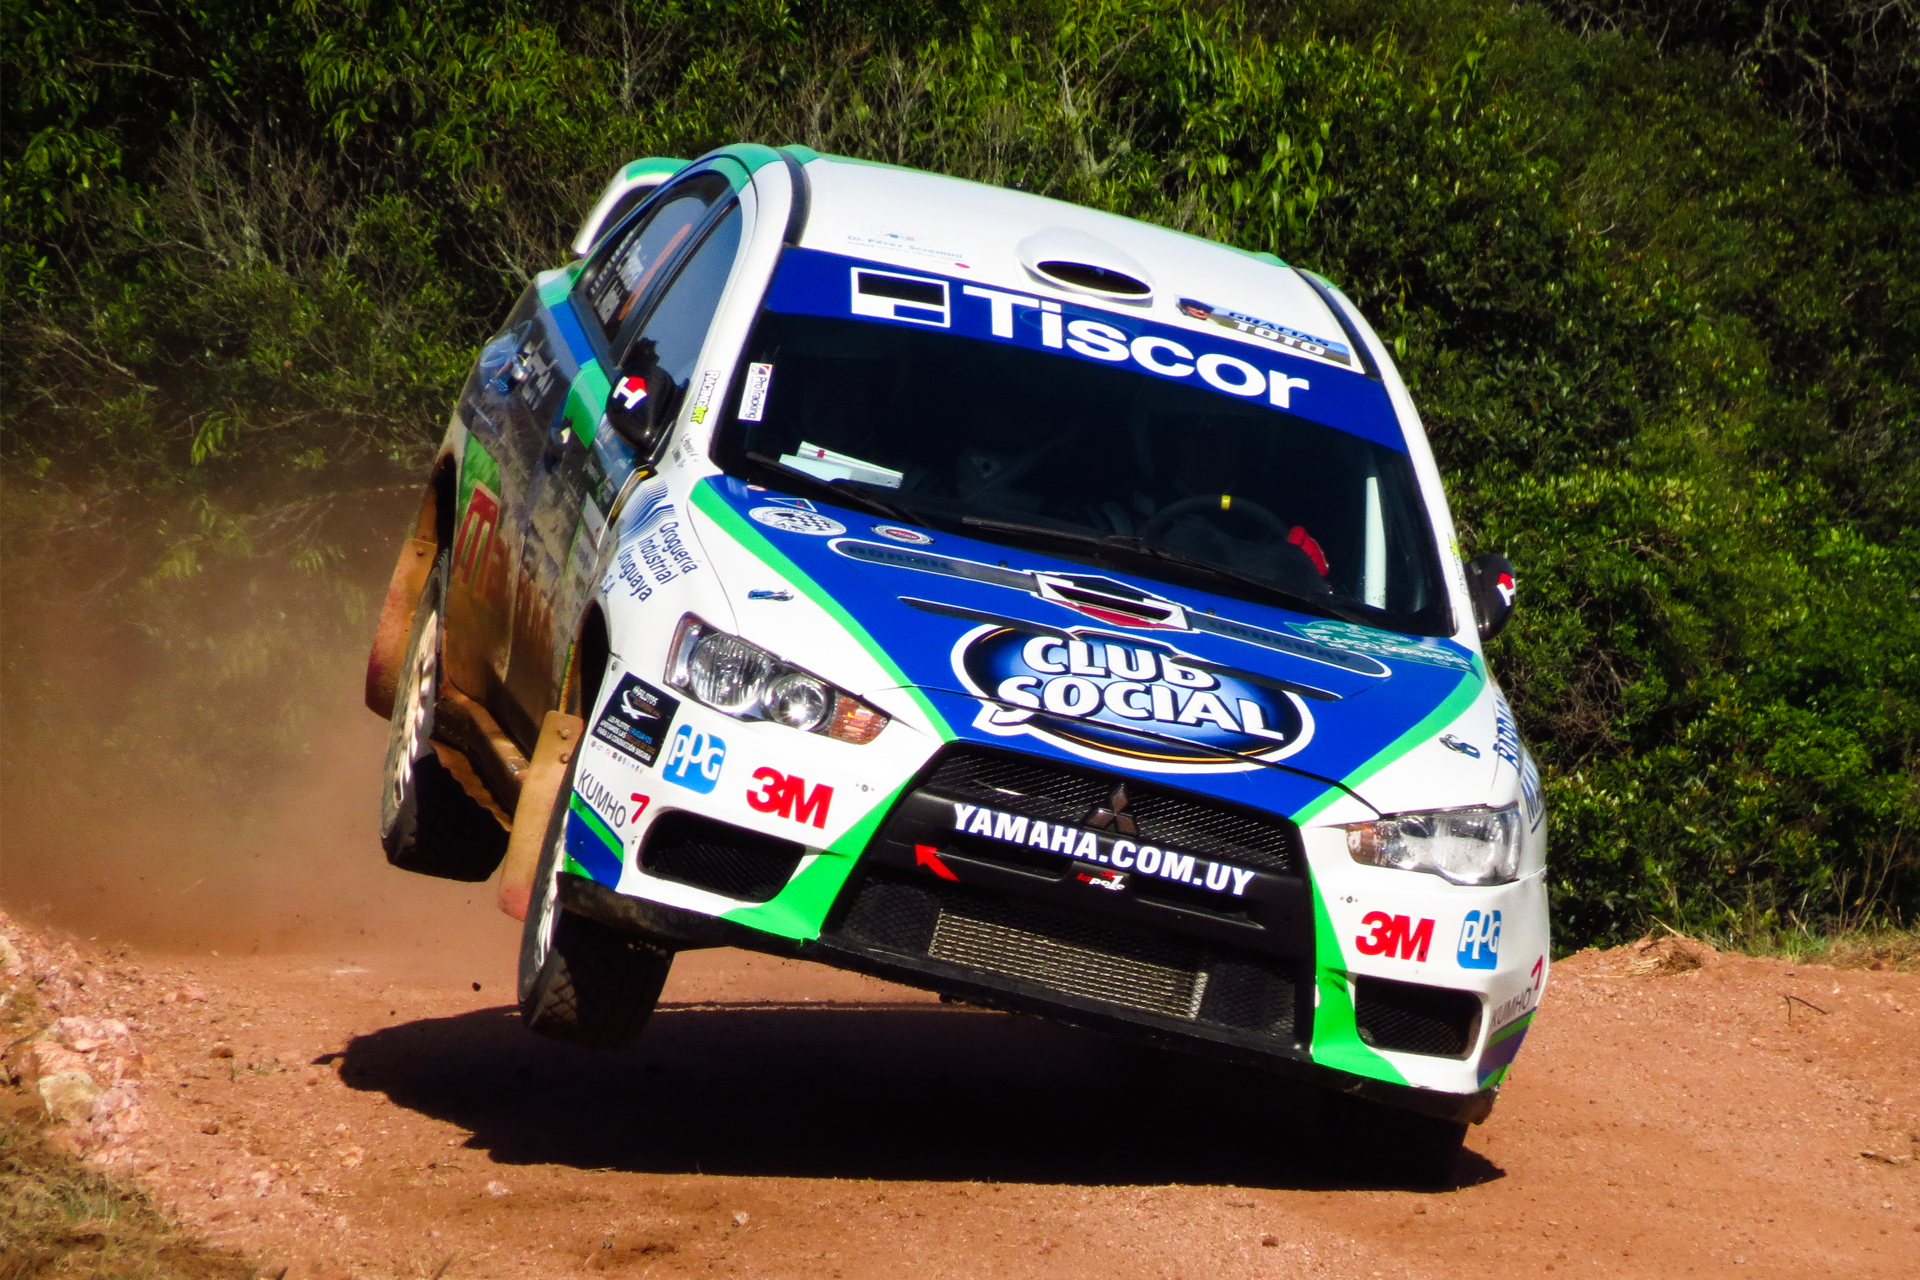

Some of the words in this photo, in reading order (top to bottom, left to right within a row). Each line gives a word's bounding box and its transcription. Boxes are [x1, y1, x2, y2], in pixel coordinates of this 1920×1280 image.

[963, 285, 1309, 409] Tiscor
[1229, 312, 1329, 347] GRACIAS
[1233, 320, 1326, 356] TOTO
[745, 376, 768, 420] ProTracking
[618, 545, 653, 602] Uruguaya
[638, 532, 679, 585] Industrial
[1023, 636, 1217, 690] CLUB
[990, 676, 1284, 741] SOCIAL
[667, 728, 725, 783] PPG
[577, 768, 627, 829] KUMHO
[746, 766, 835, 830] 3M
[954, 803, 1255, 896] YAMAHA.COM.UY
[1355, 910, 1436, 963] 3M
[1458, 912, 1501, 960] PPG
[1490, 987, 1532, 1029] KUMHO
